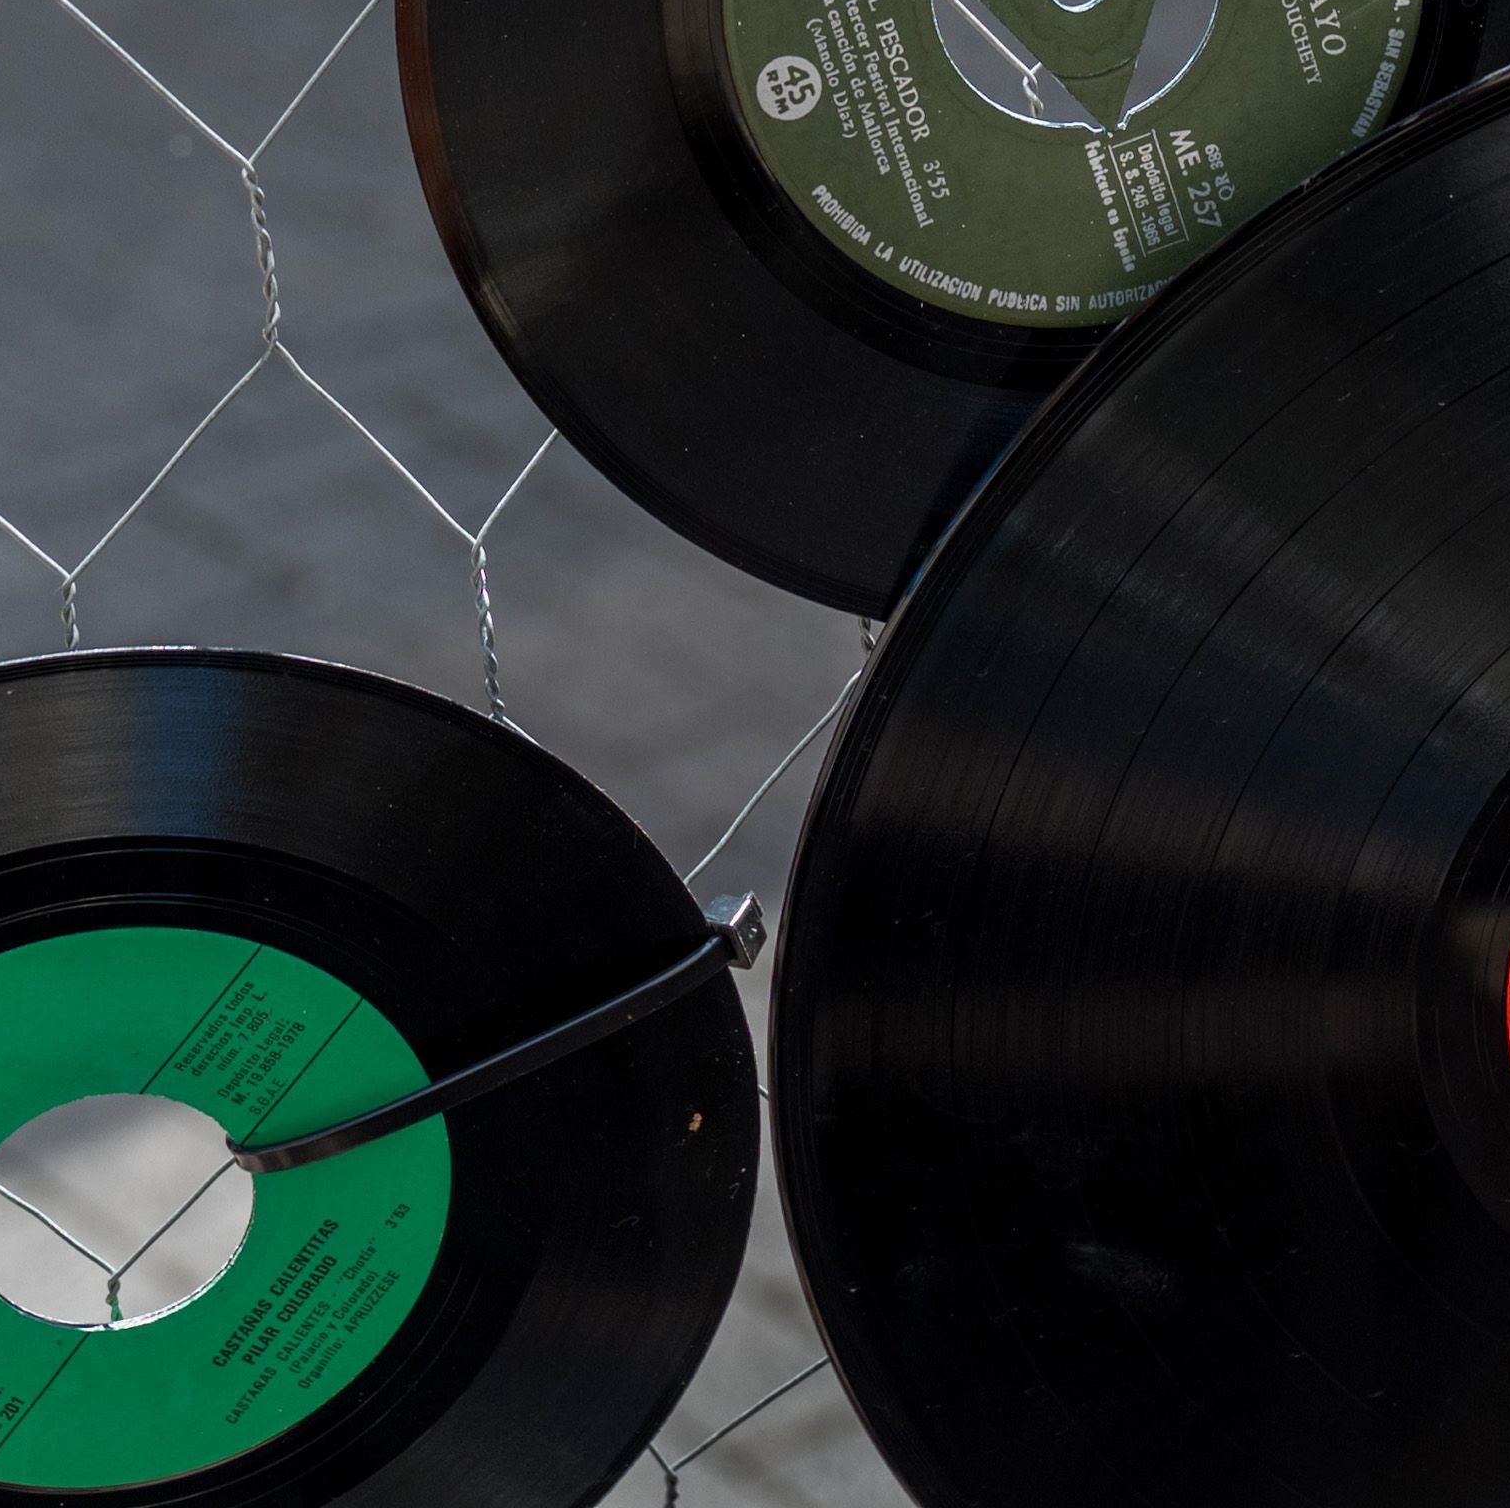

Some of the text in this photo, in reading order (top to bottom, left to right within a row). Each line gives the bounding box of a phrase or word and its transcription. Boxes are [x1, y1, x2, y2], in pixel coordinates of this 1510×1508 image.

[804, 16, 859, 140] (Manolo Díaz)
[826, 8, 859, 76] canción
[765, 68, 791, 116] RPM
[782, 63, 817, 106] 45
[848, 76, 868, 100] de
[874, 16, 932, 144] PESCADOR
[921, 158, 952, 200] 3'55
[856, 100, 892, 177] Mallorca
[861, 48, 898, 119] Festival
[883, 116, 936, 230] Internacional
[1168, 128, 1224, 229] ME. 257
[1118, 149, 1151, 210] S. S. 245
[1136, 141, 1181, 238] Depósito legal
[872, 240, 984, 303] LA UTILIZACION
[170, 979, 257, 1076] Reservados todos
[188, 990, 269, 1080] derechos Imp. L.
[214, 1016, 296, 1100] Depósito Legal:
[214, 1045, 245, 1073] núm.
[229, 1090, 252, 1107] M.
[210, 1217, 341, 1369] CASTAÑAS CALENTITAS
[239, 1253, 339, 1367] PILAR COLORADO
[274, 1299, 332, 1363] CALIENTES
[286, 1268, 381, 1376] (Palacio y Colorado)
[342, 1268, 402, 1336] APRUZZESE
